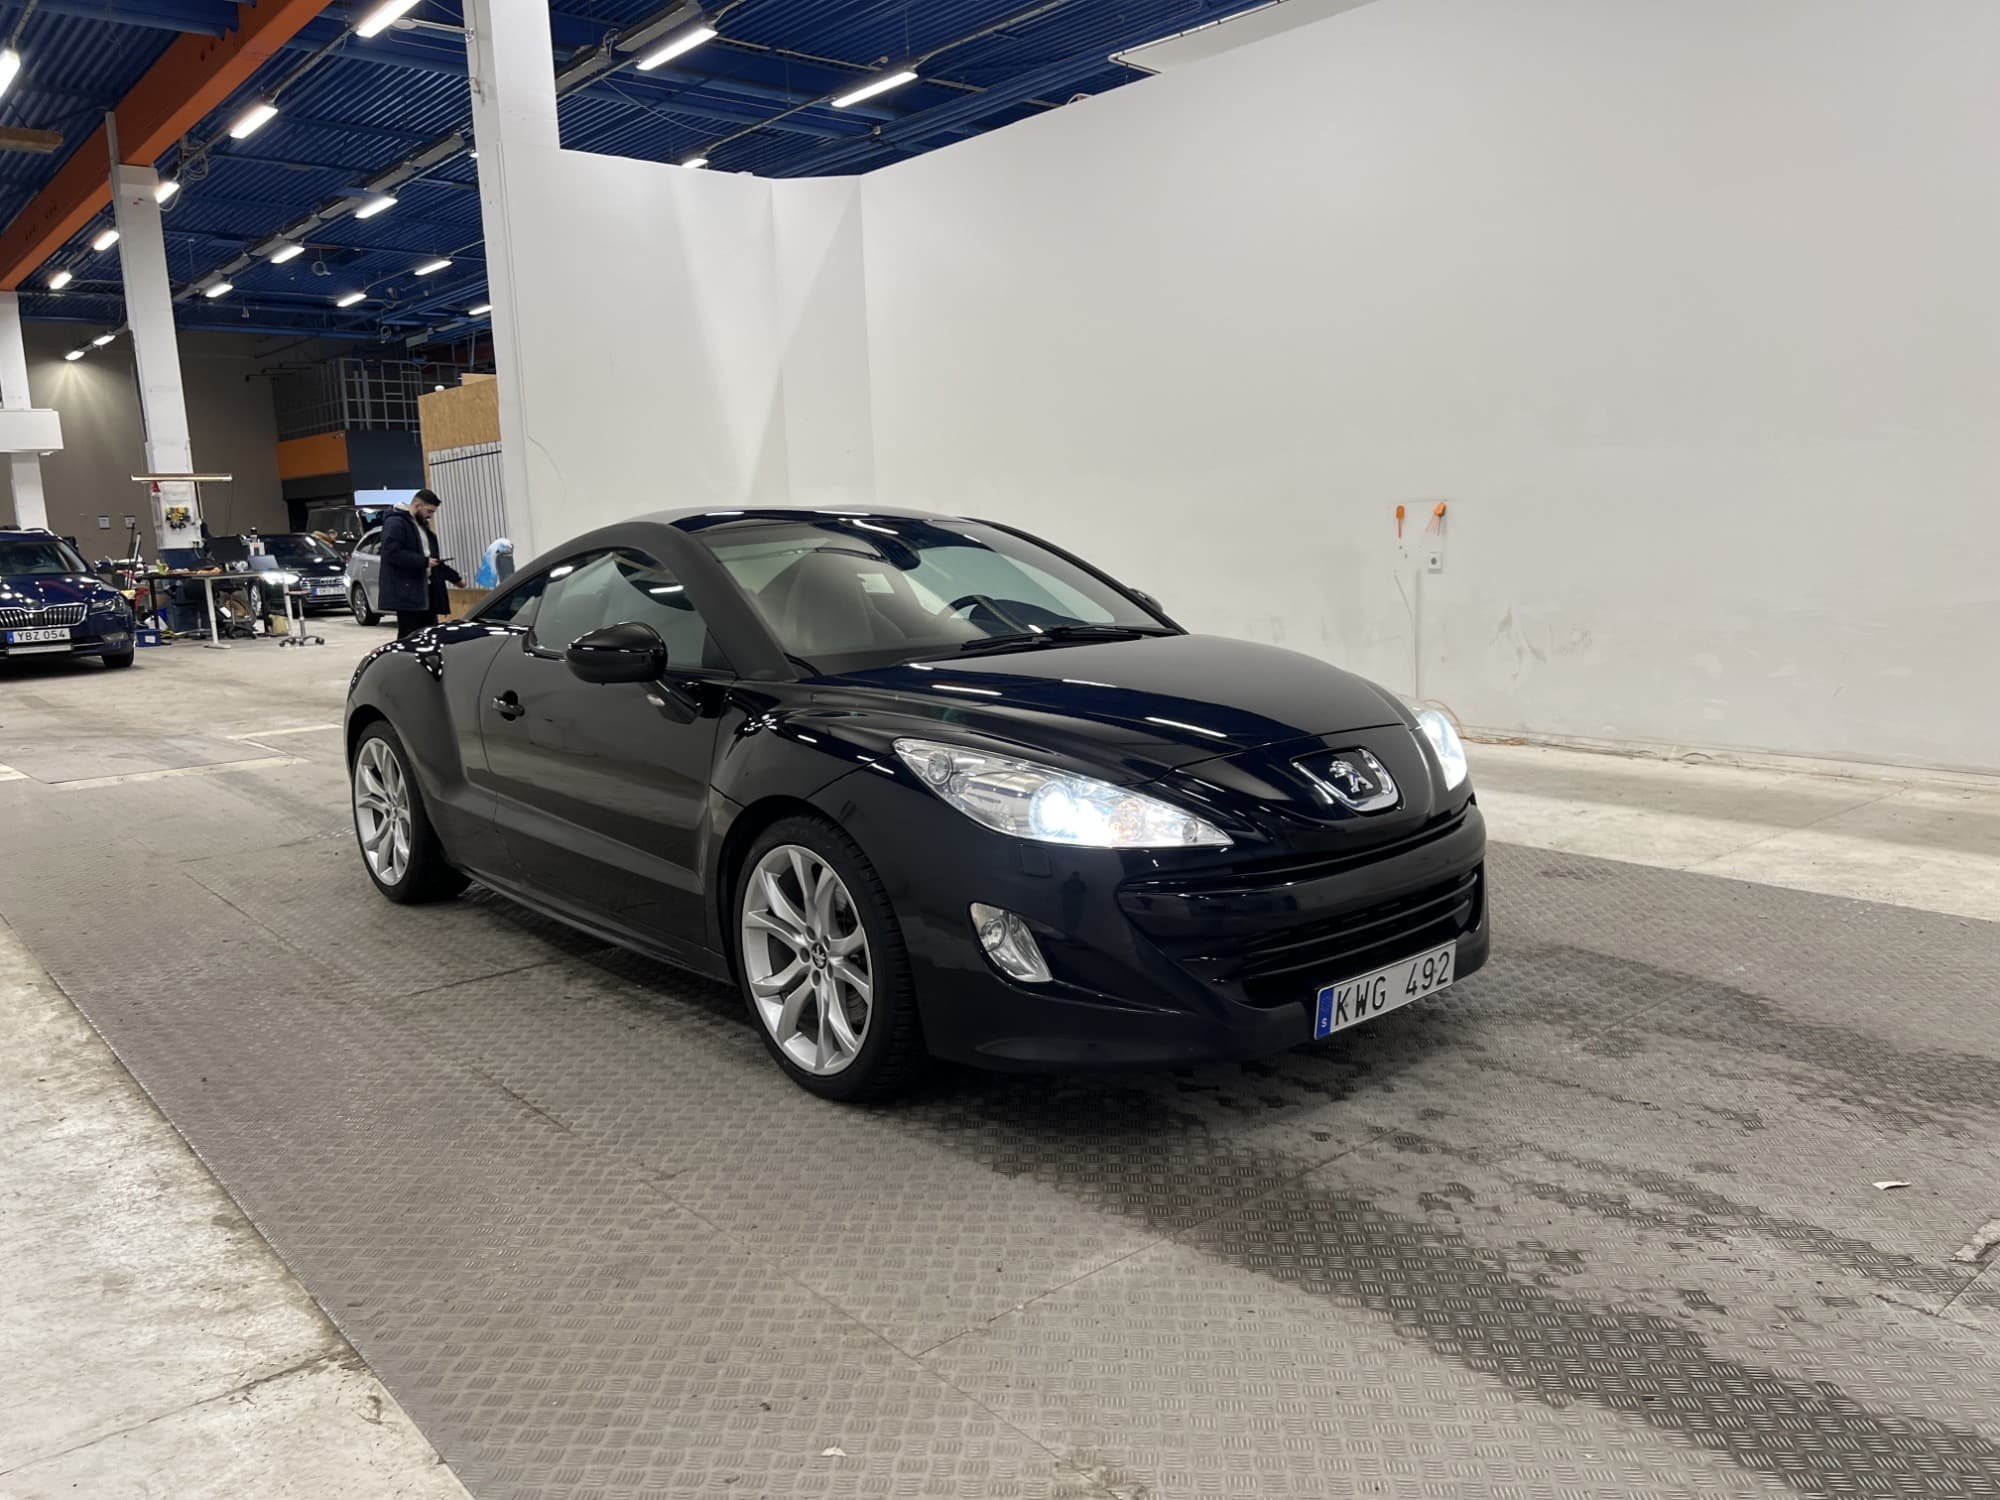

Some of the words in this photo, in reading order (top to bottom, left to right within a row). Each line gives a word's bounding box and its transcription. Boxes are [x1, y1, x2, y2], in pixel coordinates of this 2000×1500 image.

[17, 631, 40, 641] YBZ
[43, 630, 65, 640] 054
[1335, 976, 1386, 1026] KWG
[1405, 951, 1450, 996] 492
[1321, 1018, 1327, 1028] S
